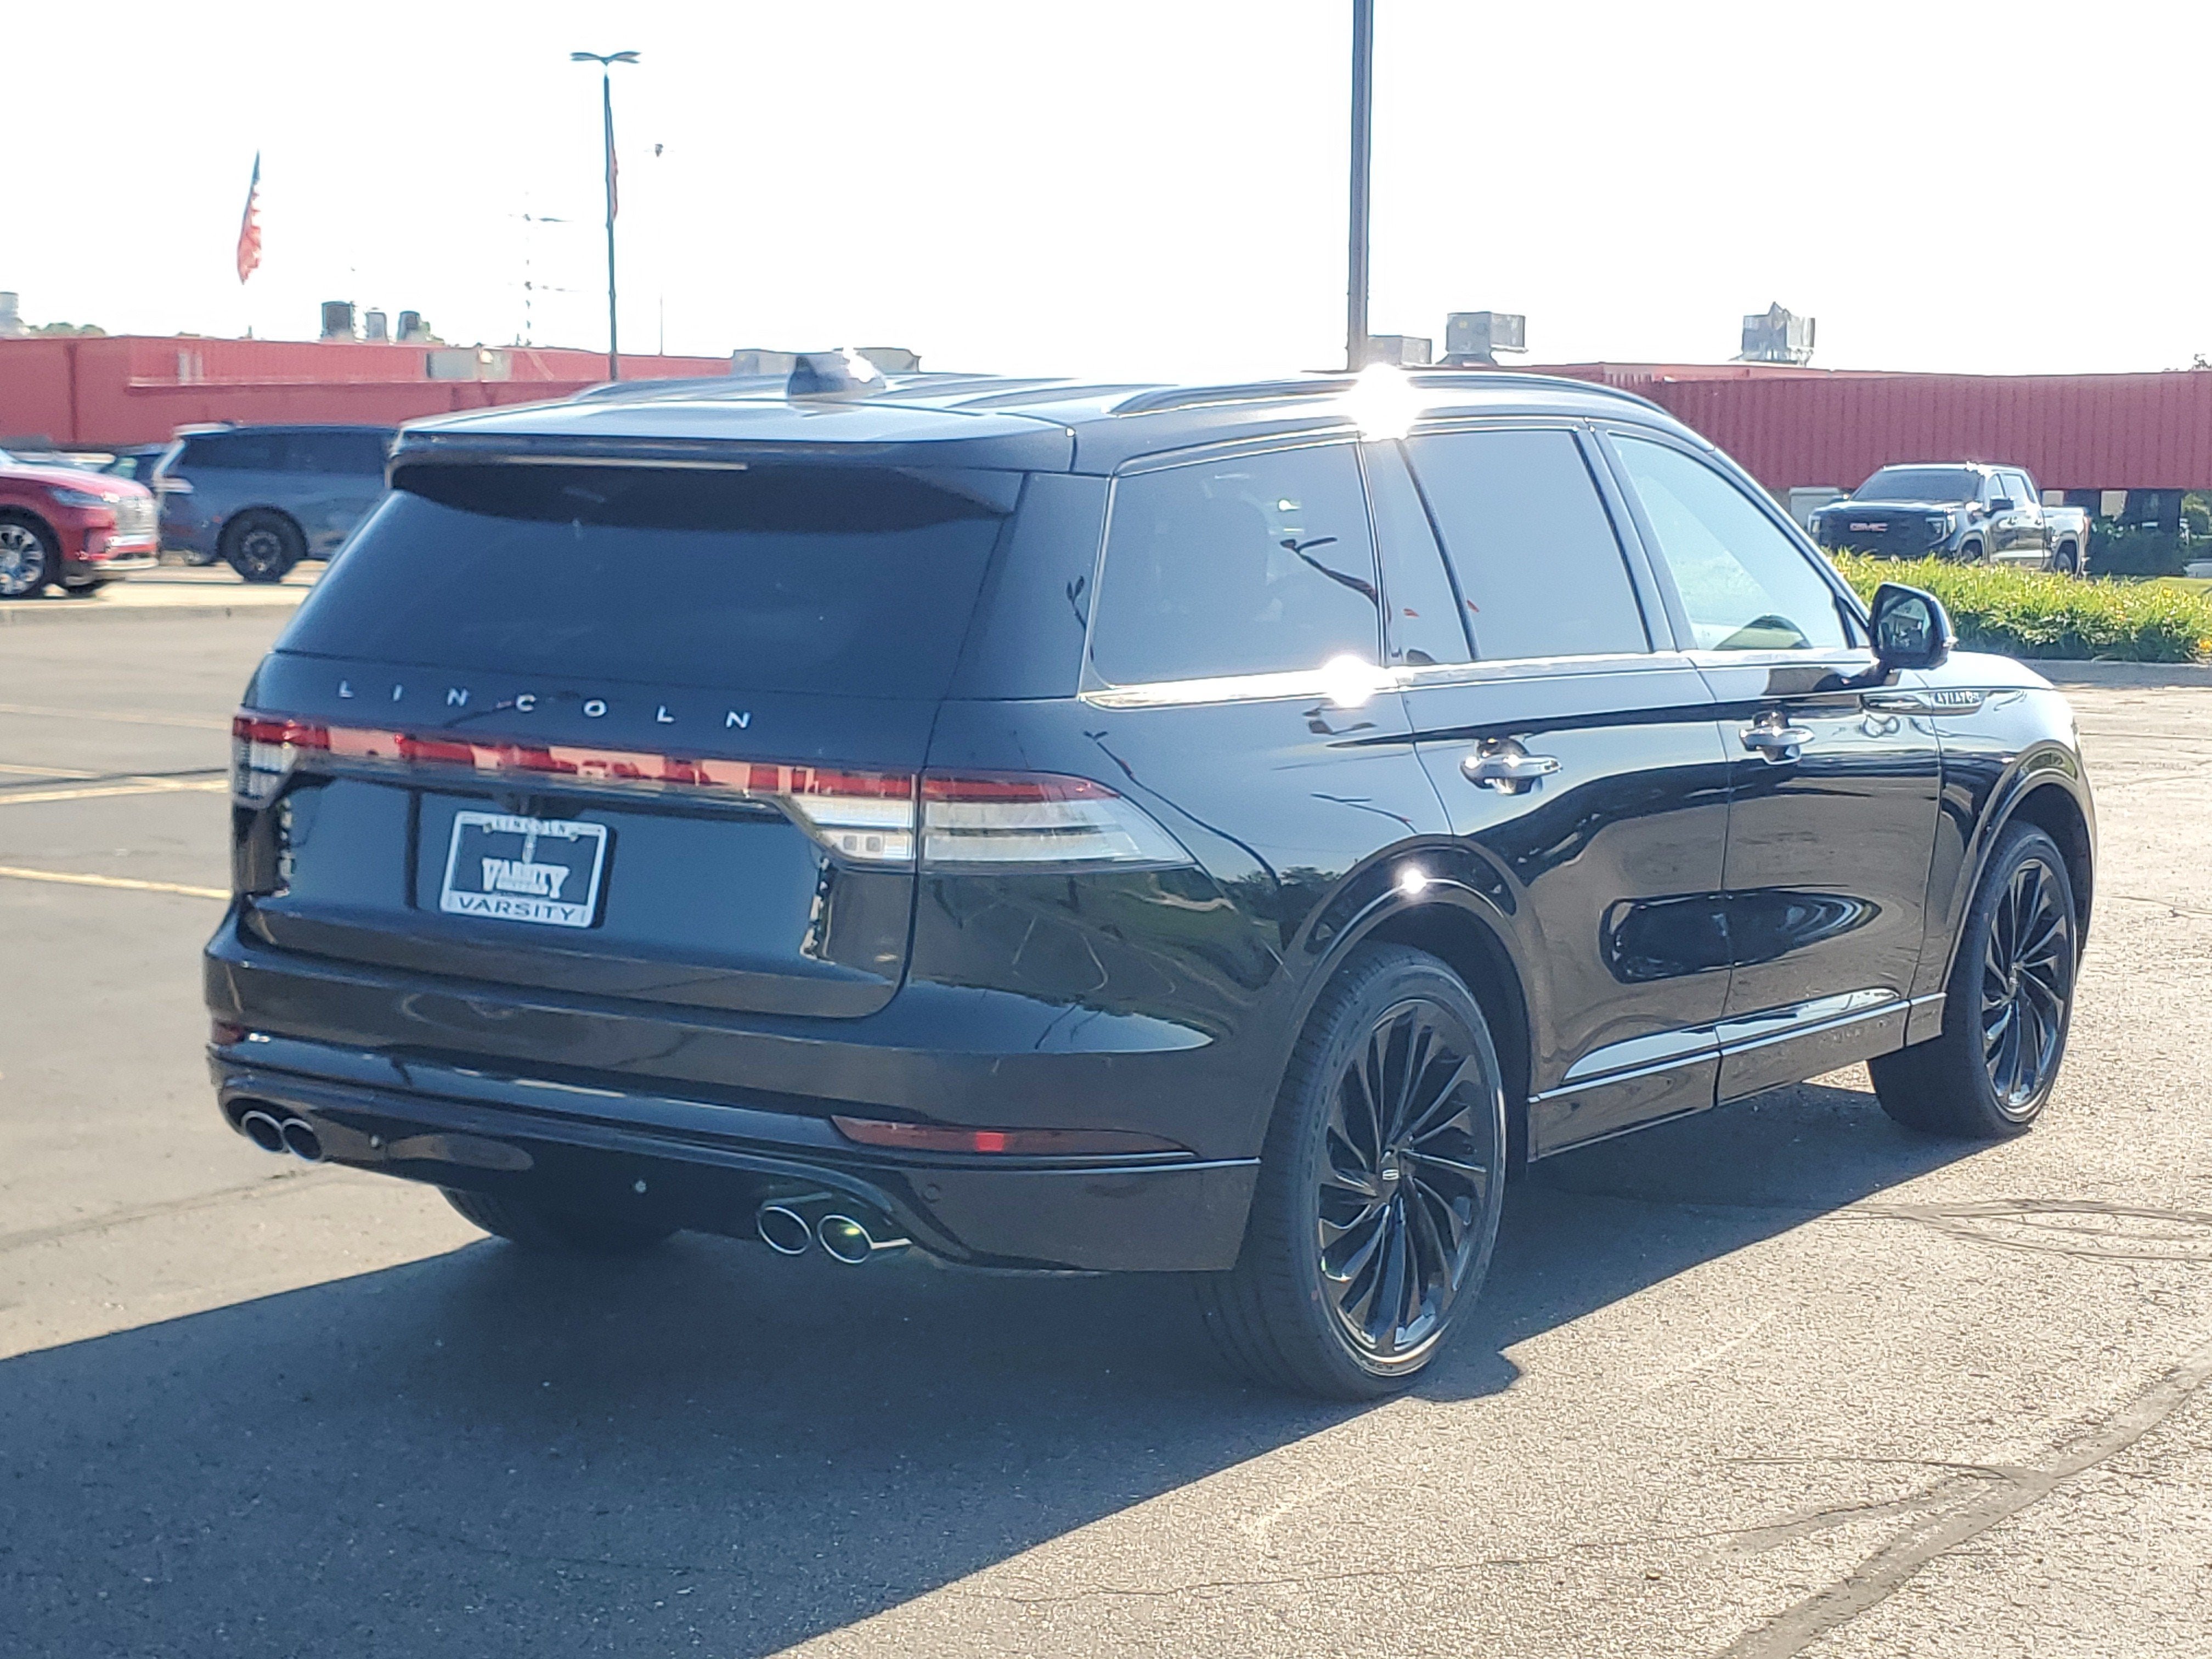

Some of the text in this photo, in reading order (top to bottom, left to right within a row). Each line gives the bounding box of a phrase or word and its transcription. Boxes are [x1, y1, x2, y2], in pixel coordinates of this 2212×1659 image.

[1849, 523, 1888, 532] GMC
[338, 680, 751, 729] LINCOLN
[459, 896, 575, 921] VARSITY
